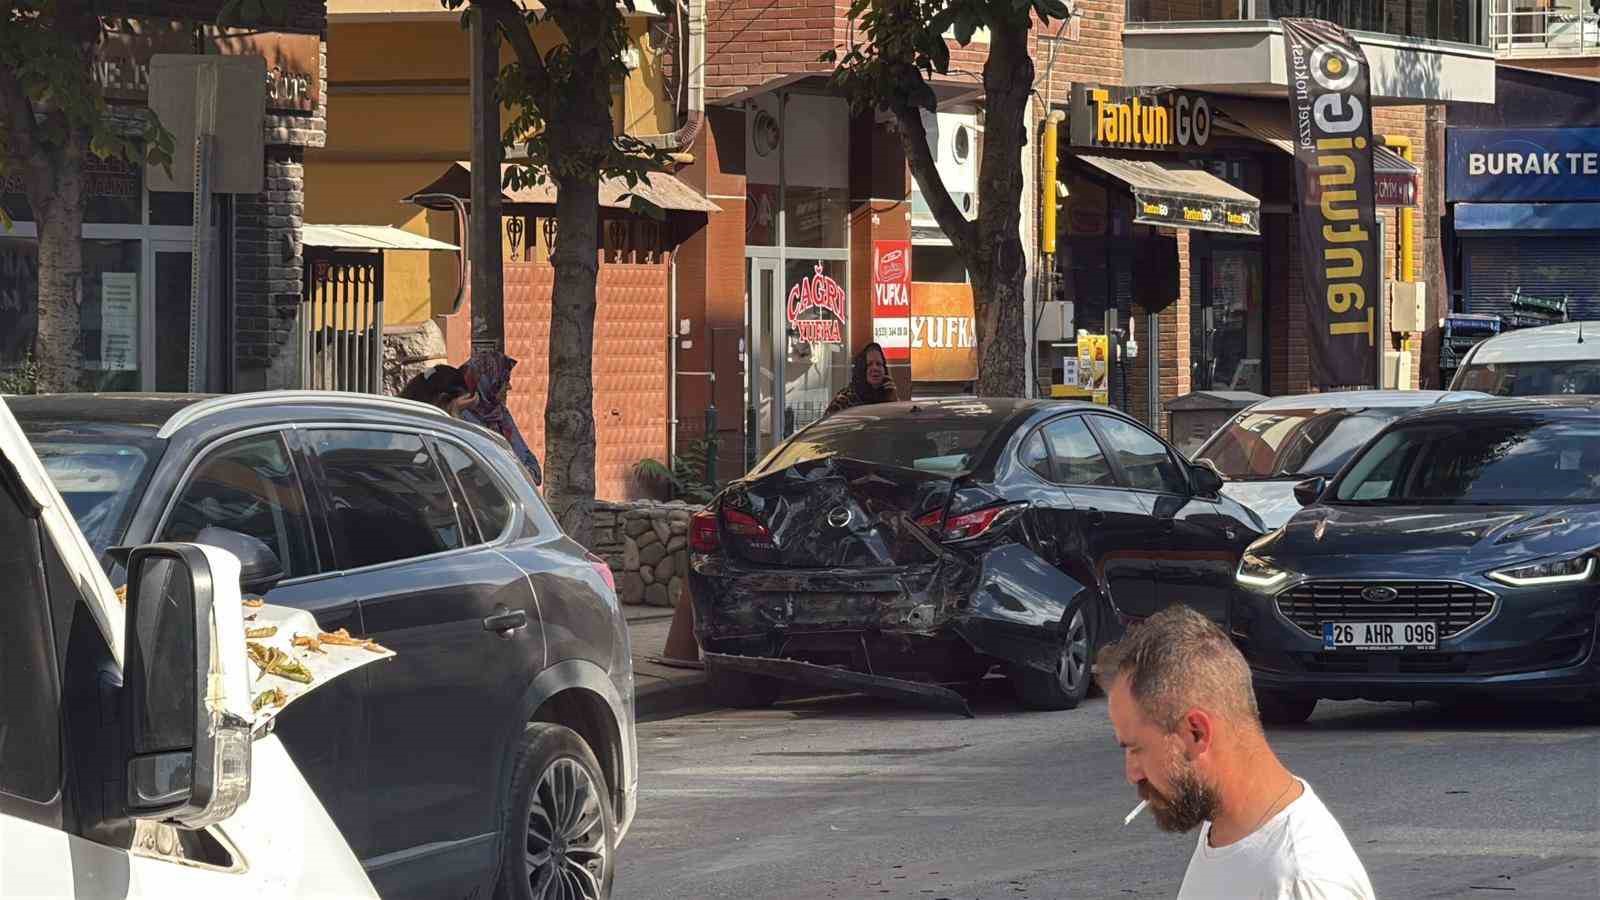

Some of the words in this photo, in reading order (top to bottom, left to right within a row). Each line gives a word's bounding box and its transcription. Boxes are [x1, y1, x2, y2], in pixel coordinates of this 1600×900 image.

[1092, 88, 1210, 146] TantuniGO
[1469, 153, 1559, 176] BURAK
[875, 284, 908, 306] YUFKA
[798, 320, 841, 343] YUFKA
[1334, 625, 1354, 644] 26
[1365, 624, 1394, 644] AHR
[1404, 624, 1434, 643] 096
